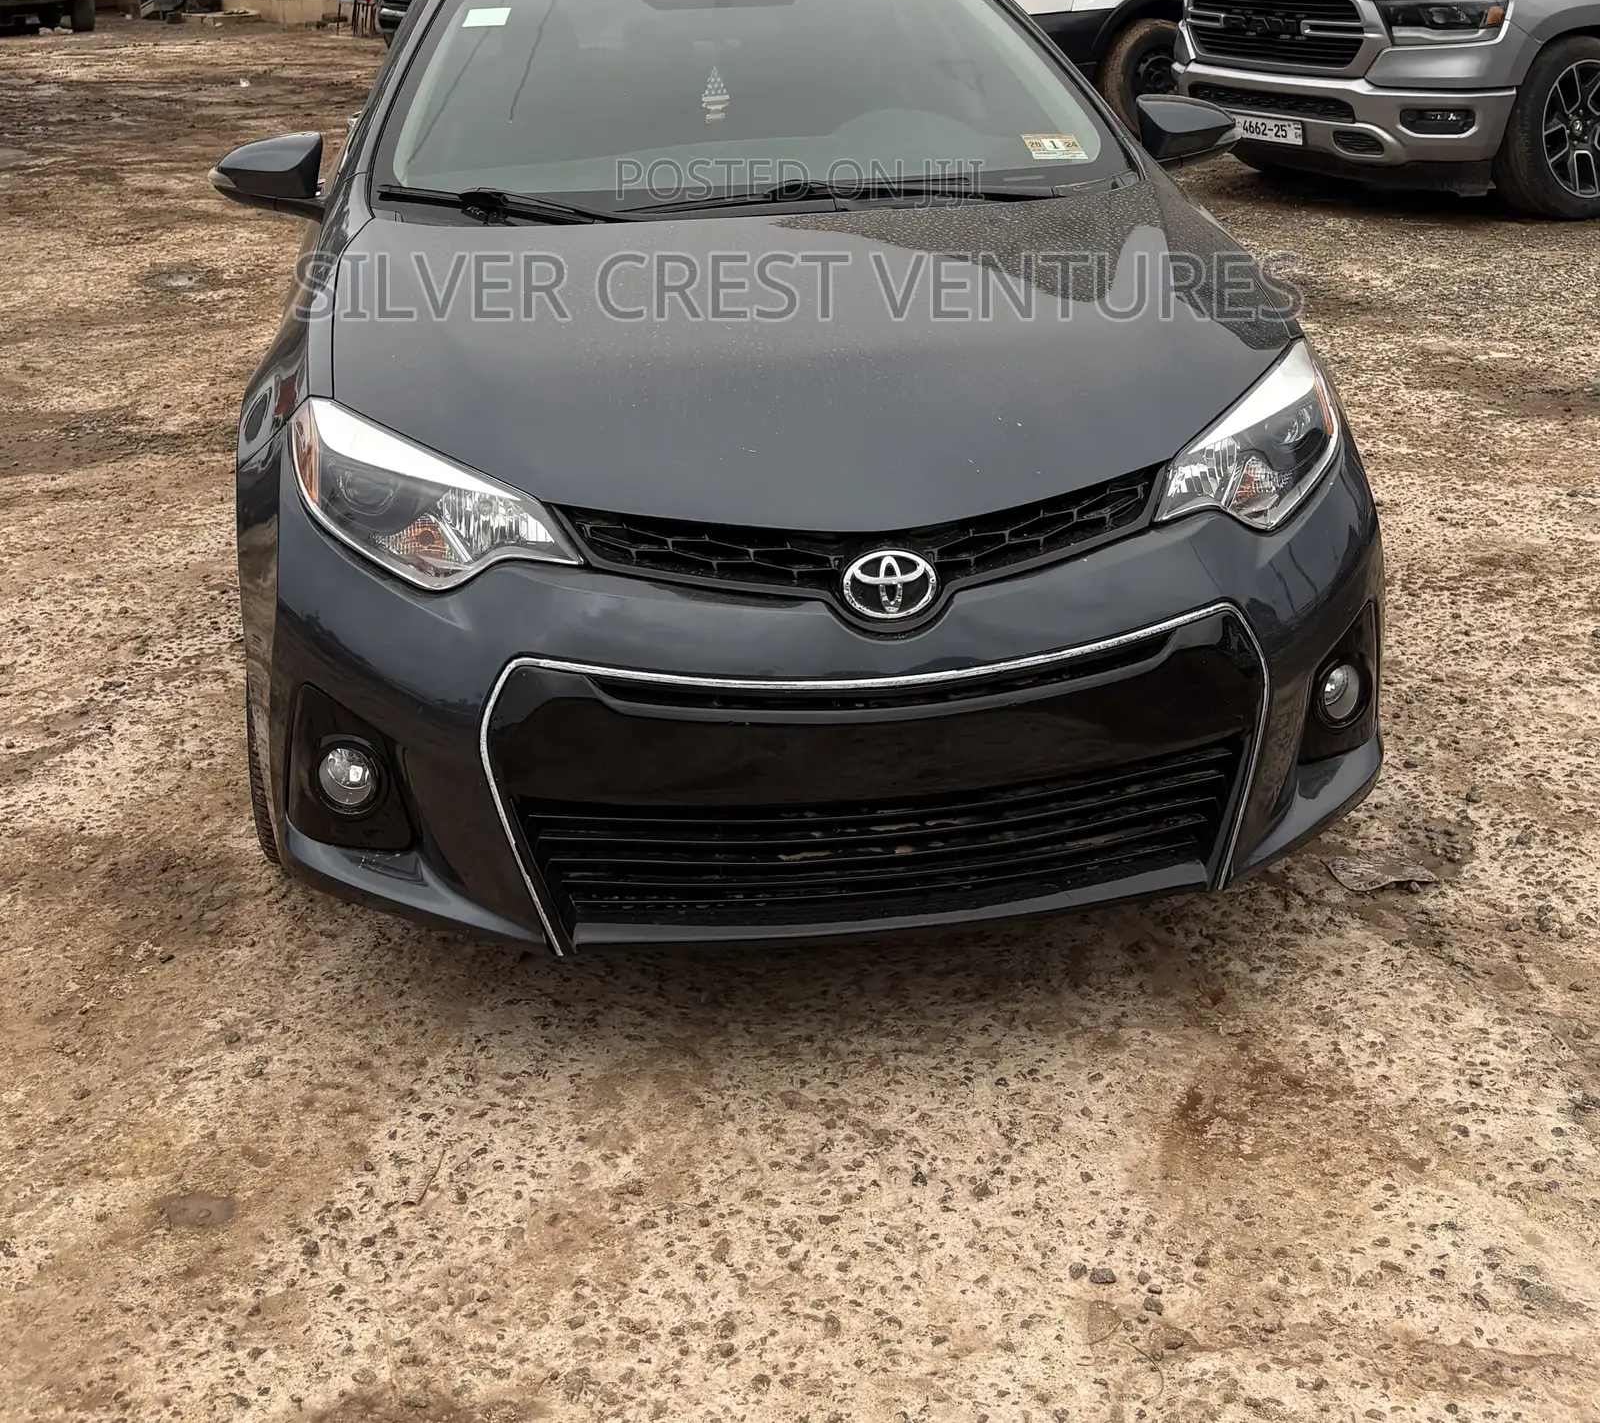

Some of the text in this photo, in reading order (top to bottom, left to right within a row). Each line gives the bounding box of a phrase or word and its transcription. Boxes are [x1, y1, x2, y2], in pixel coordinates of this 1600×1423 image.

[1222, 13, 1300, 34] RAM
[1242, 119, 1287, 139] 4662-25
[1049, 140, 1060, 149] 1
